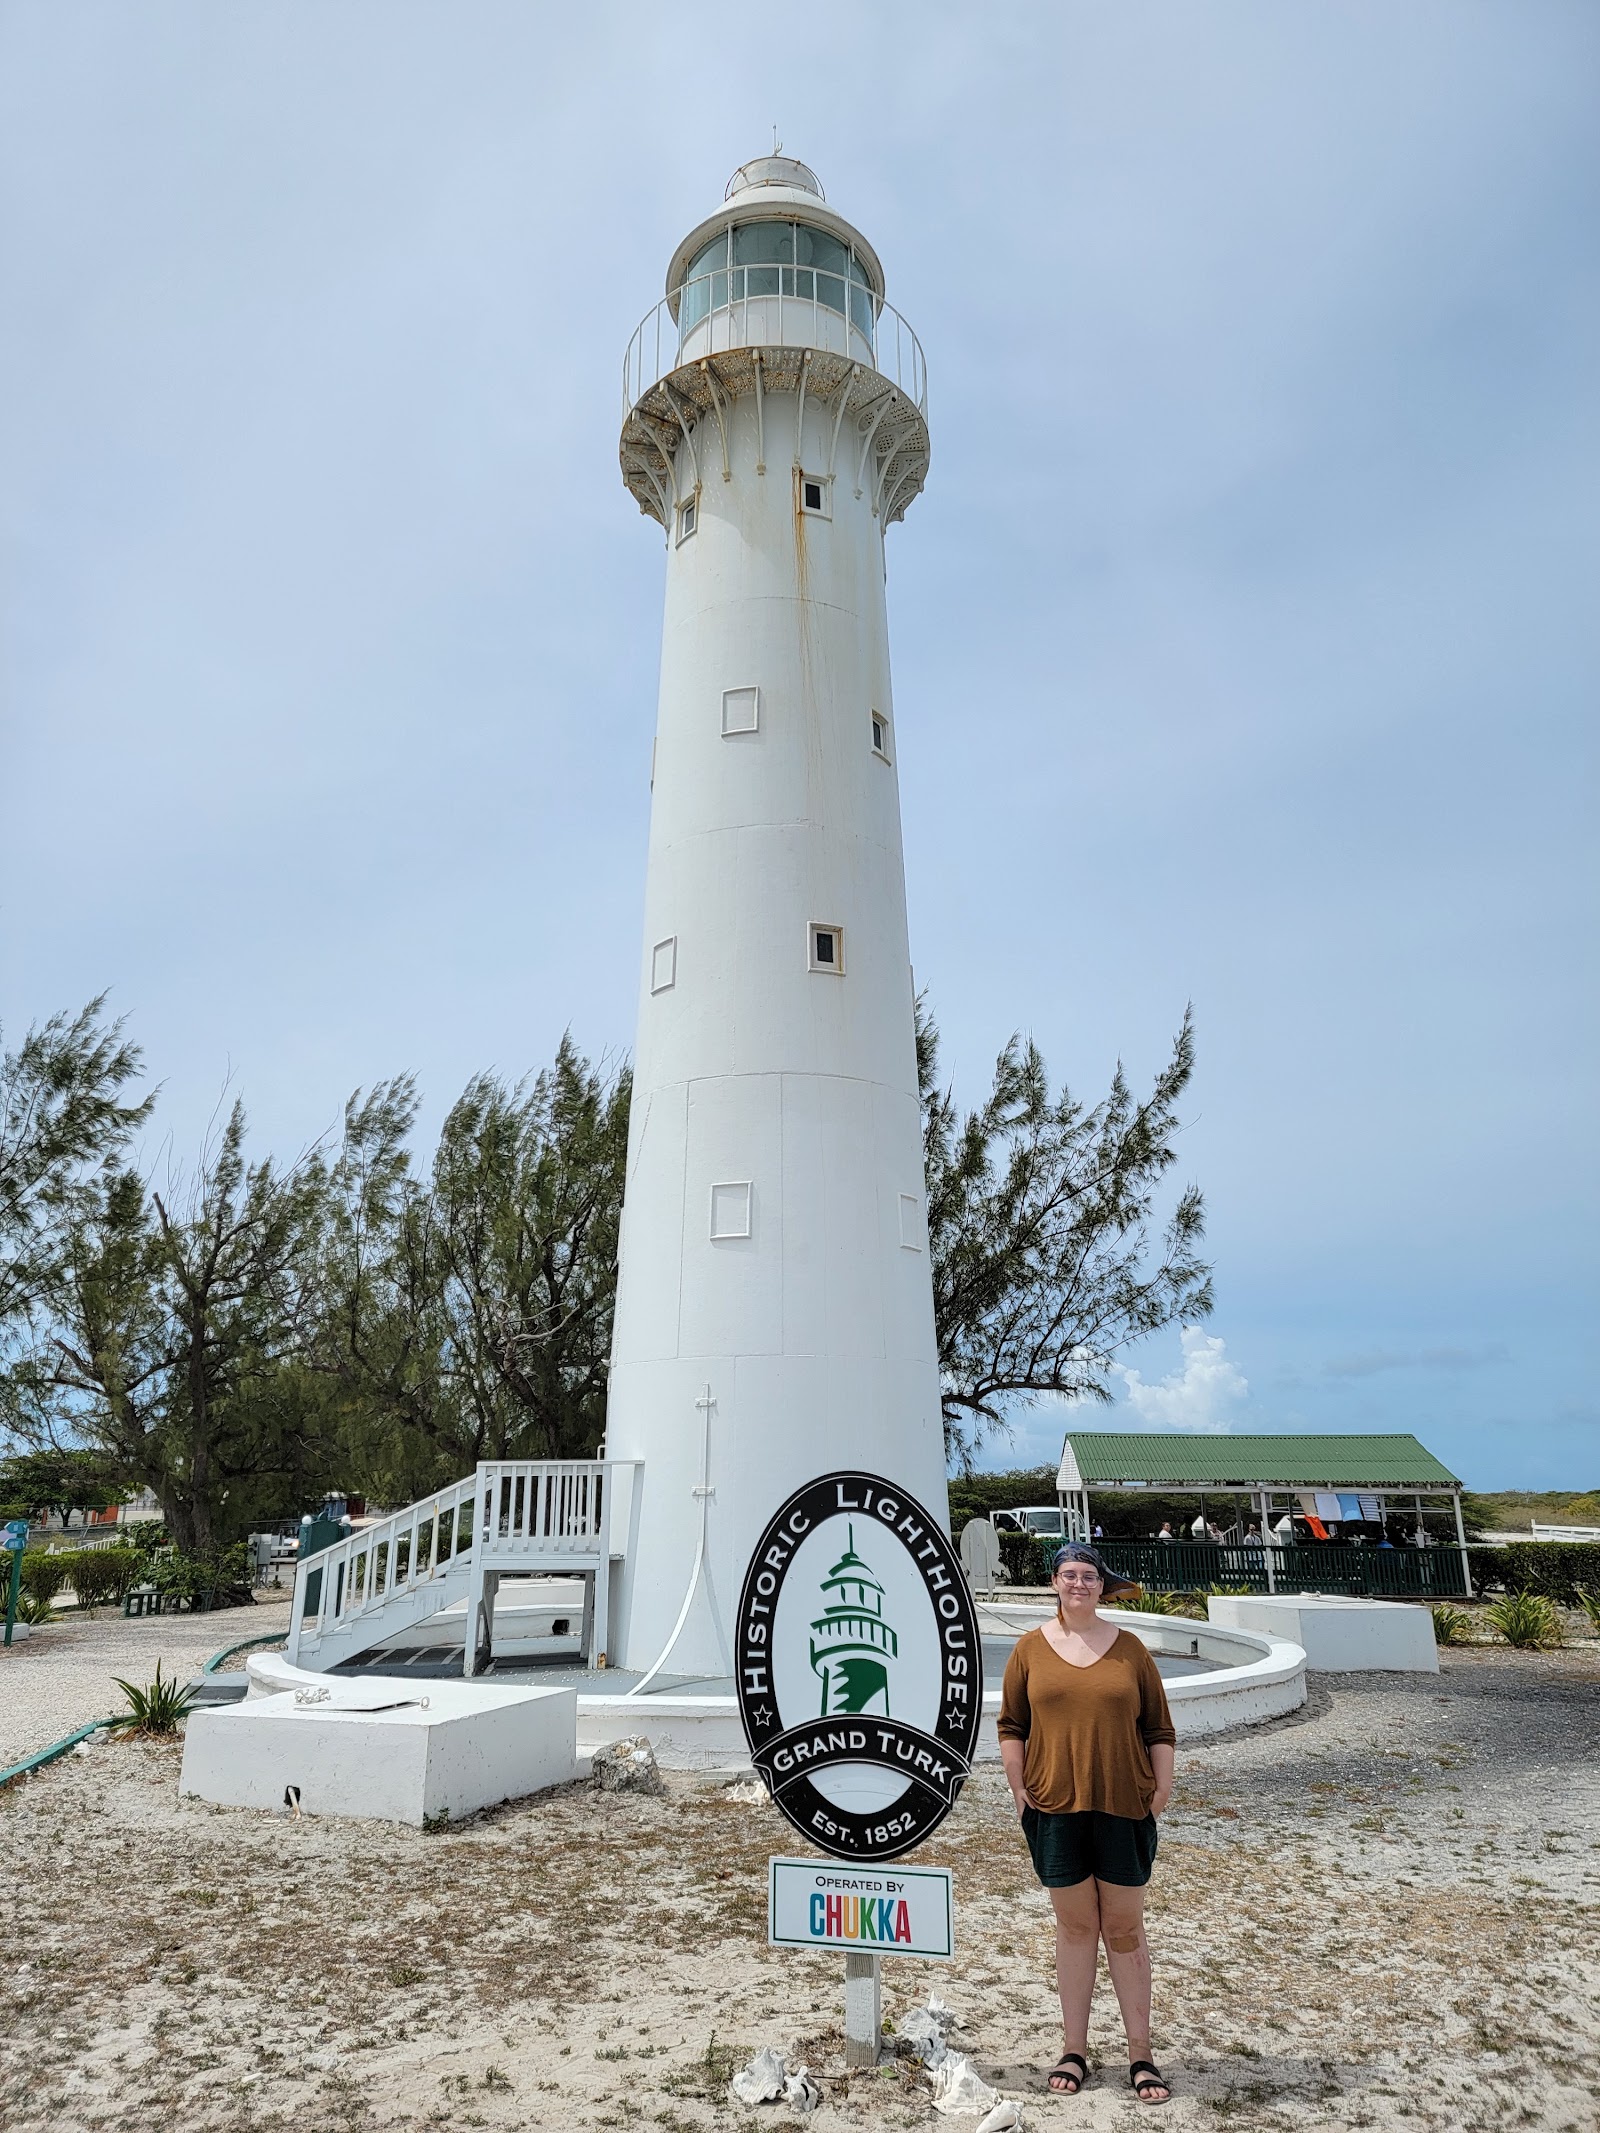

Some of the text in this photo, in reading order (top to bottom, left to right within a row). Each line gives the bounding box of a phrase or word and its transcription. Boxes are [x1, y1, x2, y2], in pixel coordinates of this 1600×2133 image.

[745, 1484, 968, 1704] HISTORIC LIGHTHOUSE
[773, 1731, 951, 1784] GRAND TURK
[811, 1810, 917, 1844] EST. 1852
[815, 1876, 905, 1893] OPERATED BY
[810, 1893, 912, 1943] CHUKKA
